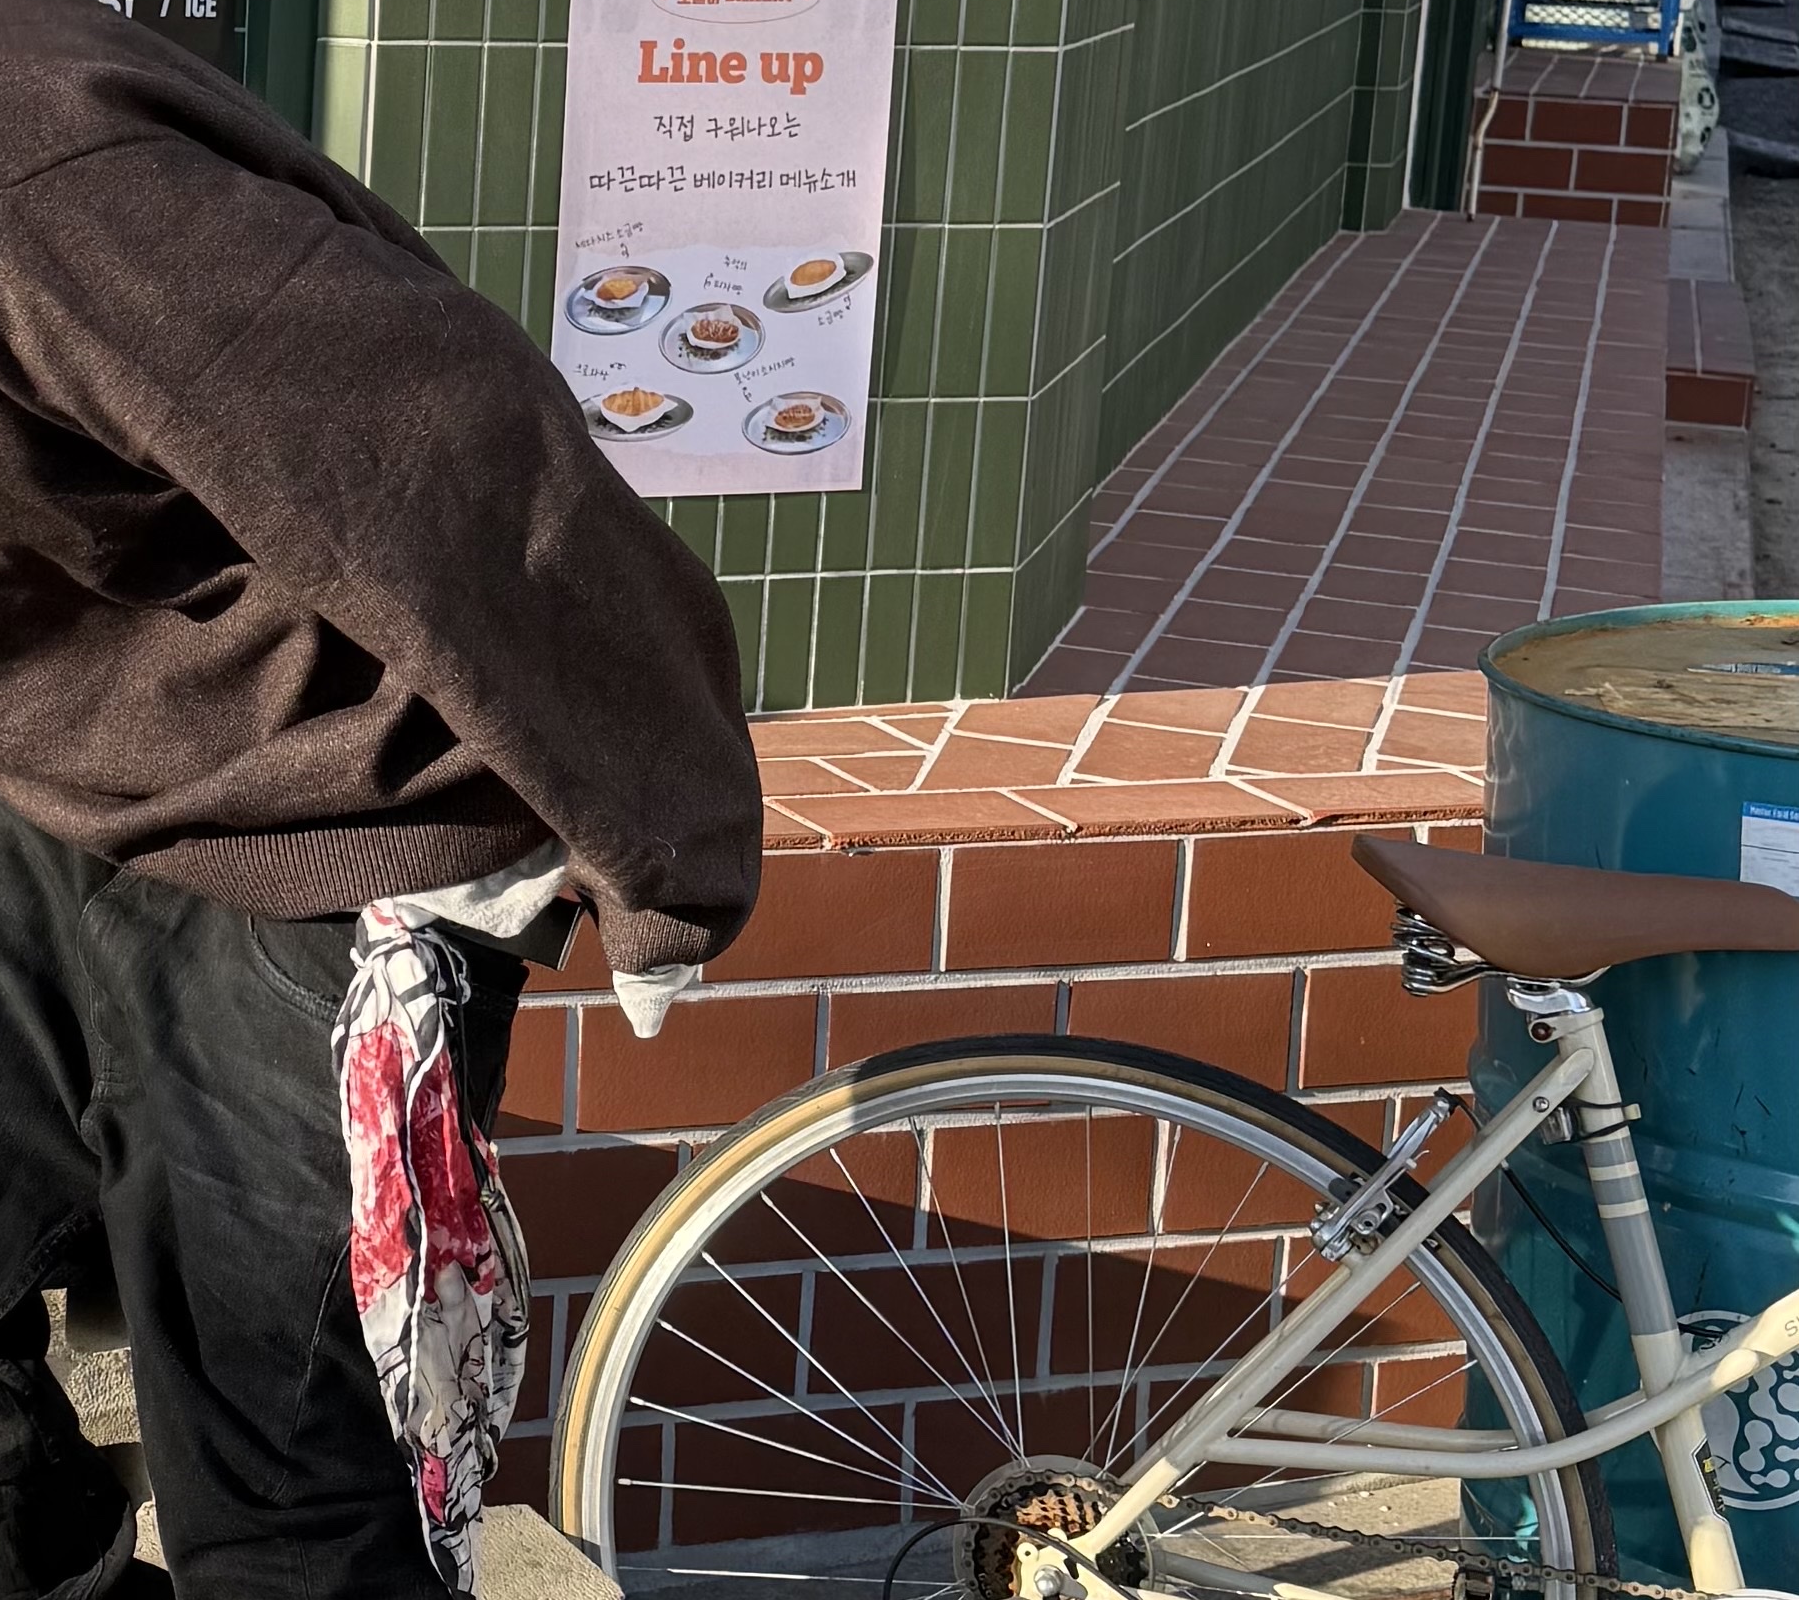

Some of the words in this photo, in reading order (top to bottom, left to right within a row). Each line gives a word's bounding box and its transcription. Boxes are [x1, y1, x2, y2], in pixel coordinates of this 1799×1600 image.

[637, 37, 748, 84] Line
[760, 51, 825, 96] up
[653, 114, 695, 142] 직접
[705, 112, 801, 142] 구워나오는
[589, 164, 688, 194] 따끈따끈
[693, 168, 773, 191] 베이커리
